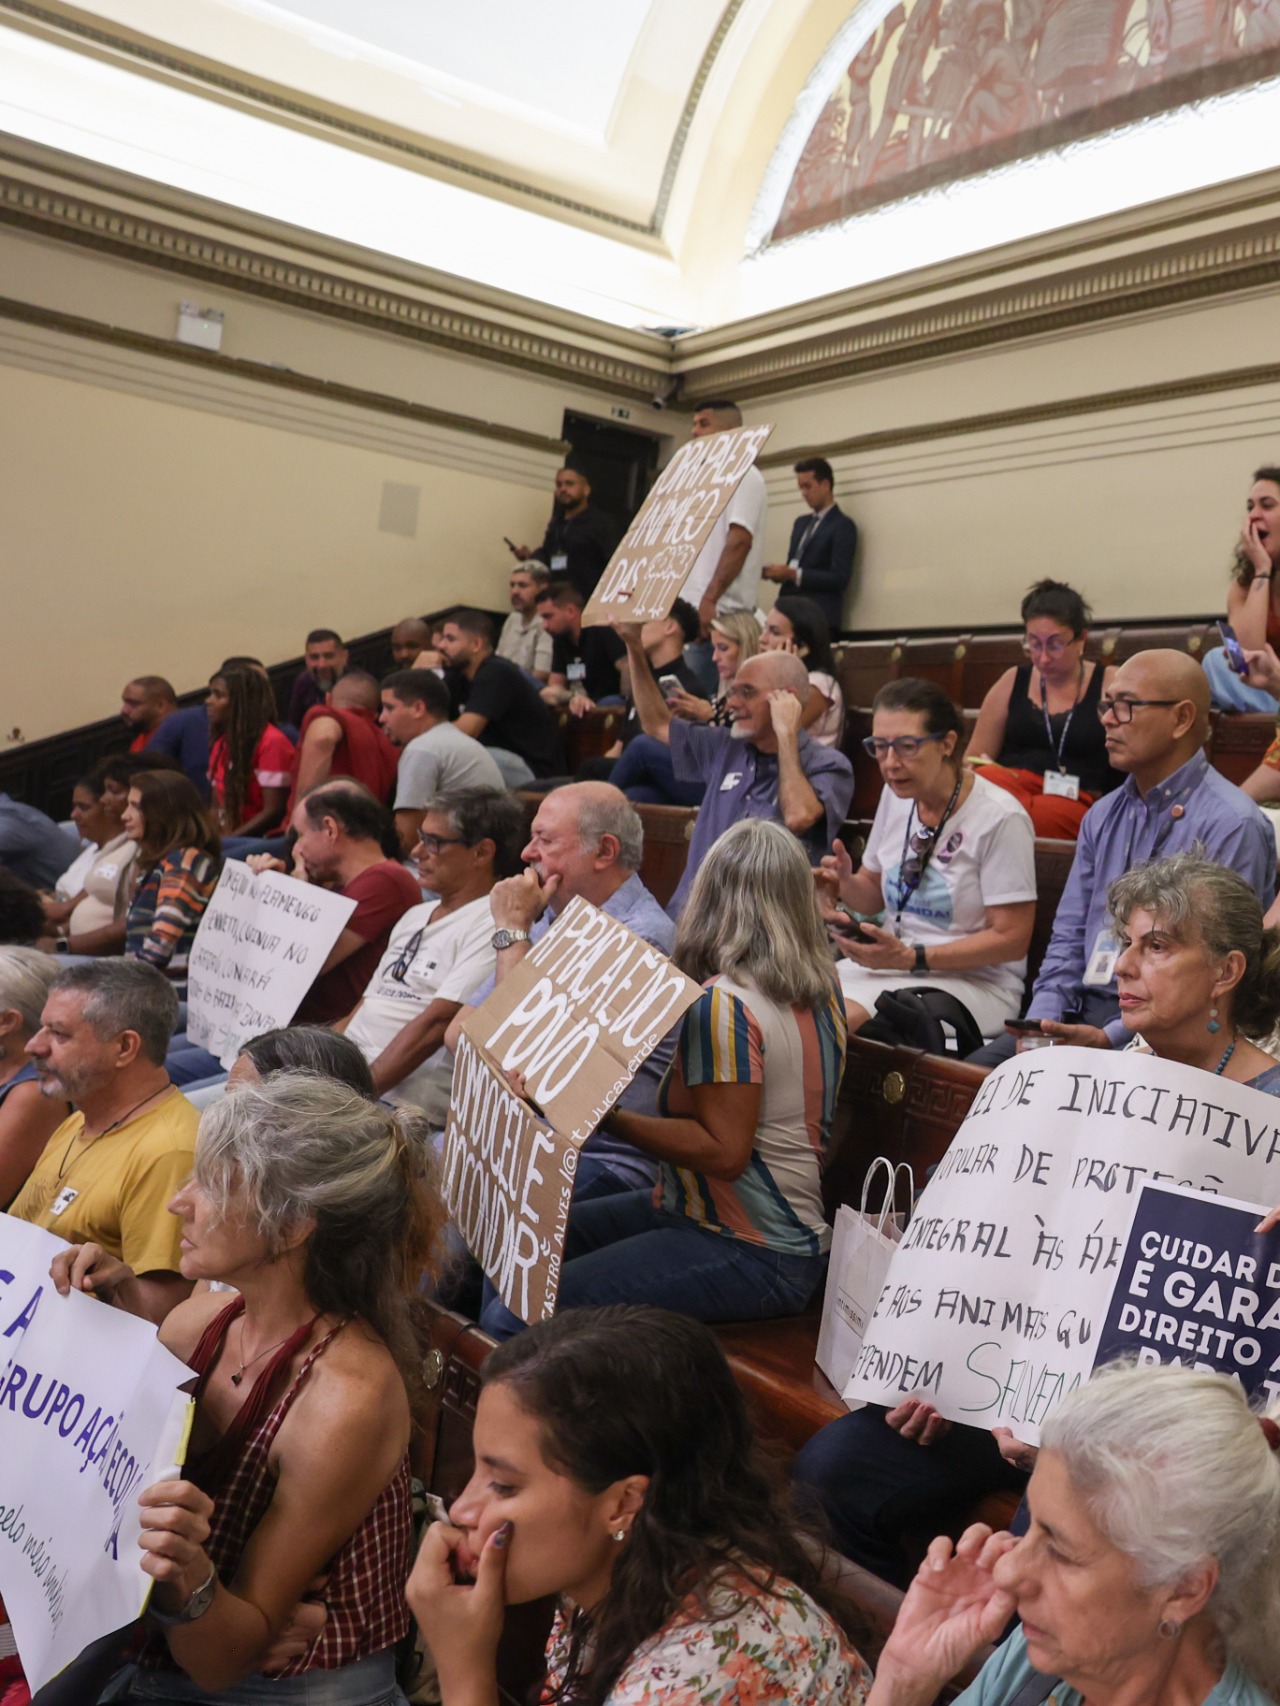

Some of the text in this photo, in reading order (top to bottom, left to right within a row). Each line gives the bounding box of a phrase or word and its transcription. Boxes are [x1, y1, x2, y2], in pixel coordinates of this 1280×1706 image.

[600, 556, 648, 604] DAS
[282, 941, 309, 965] NO
[608, 961, 685, 1047] DO
[486, 977, 600, 1107] POVO
[1001, 1069, 1045, 1110] DE
[1013, 1143, 1053, 1186] DE
[1072, 1157, 1224, 1194] PROT
[902, 1215, 1012, 1258] INTEGRAL
[1032, 1213, 1064, 1271] ÀS
[1140, 1231, 1258, 1283] CUIDAR
[885, 1283, 923, 1319] AOS
[1118, 1303, 1262, 1366] DIREITO
[851, 1344, 944, 1396] EPENDEM
[73, 1406, 124, 1477] AÇÃ
